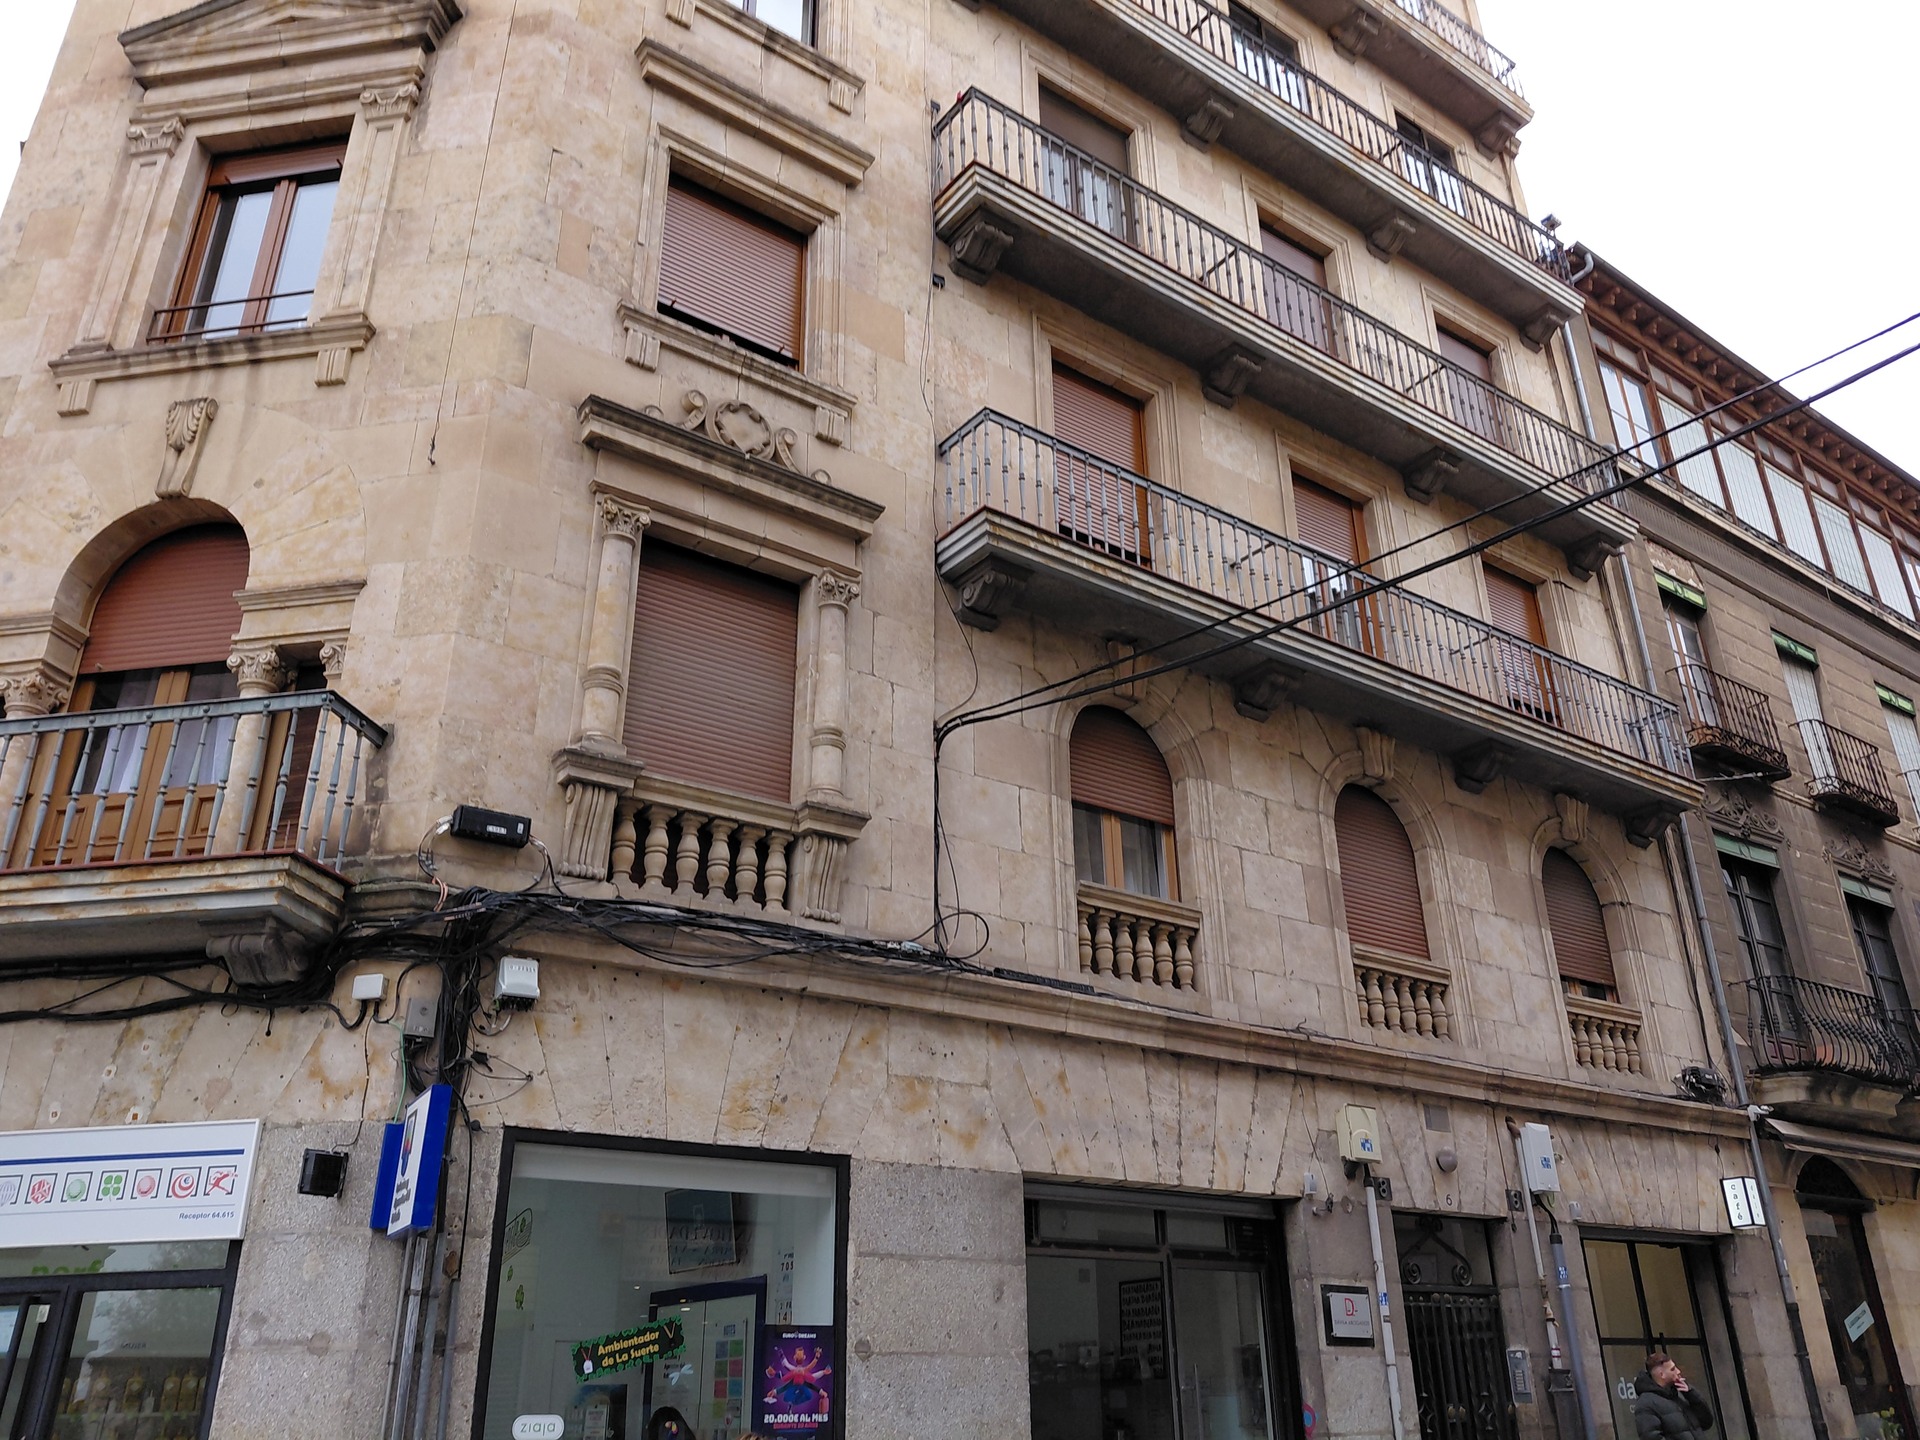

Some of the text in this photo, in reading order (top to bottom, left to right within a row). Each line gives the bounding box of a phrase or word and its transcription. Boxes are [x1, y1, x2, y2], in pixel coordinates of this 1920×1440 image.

[1446, 1193, 1453, 1206] 6
[179, 1211, 234, 1220] Receptor 64.615
[598, 1331, 660, 1356] Ambientador
[602, 1356, 614, 1367] de
[616, 1352, 628, 1363] La
[630, 1344, 660, 1359] Suerte
[800, 1413, 811, 1422] AL
[812, 1413, 828, 1422] MES
[520, 1423, 555, 1436] ziaja
